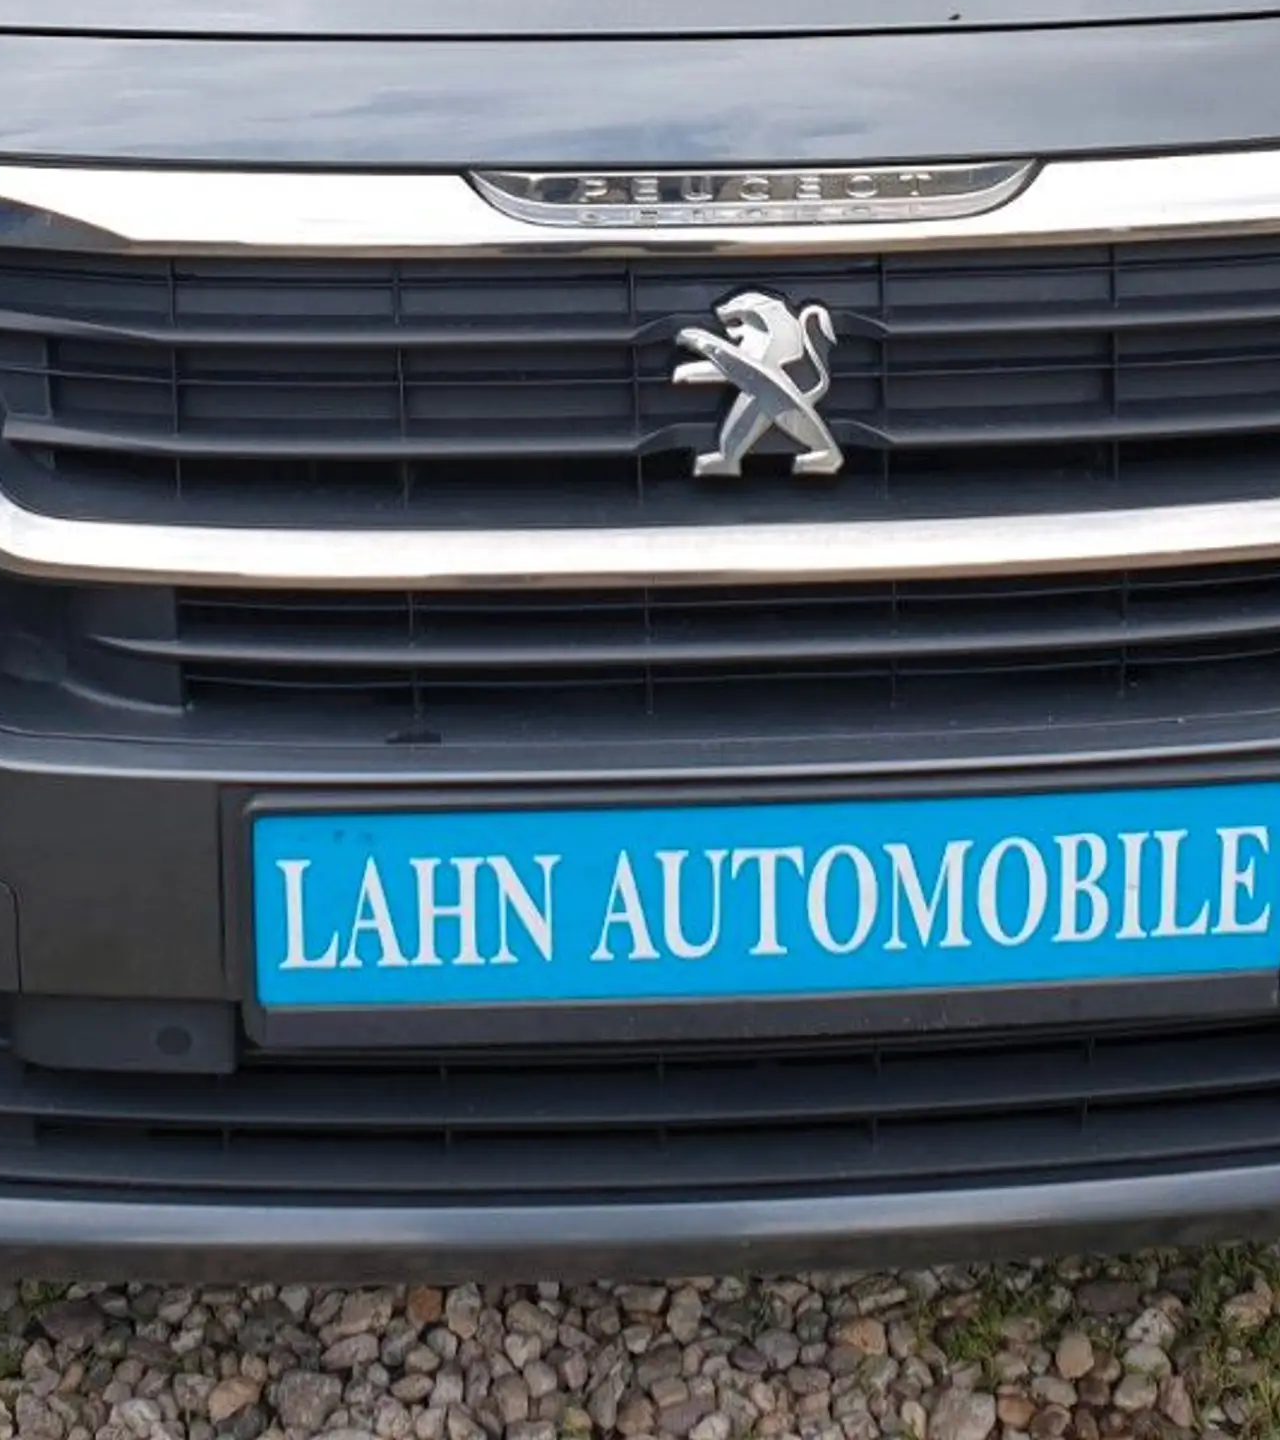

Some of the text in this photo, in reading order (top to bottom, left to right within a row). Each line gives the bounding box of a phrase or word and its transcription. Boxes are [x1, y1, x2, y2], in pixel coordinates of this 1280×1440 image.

[576, 172, 932, 203] PEUGEOT
[276, 825, 1271, 970] LAHN AUTOMOBILE
